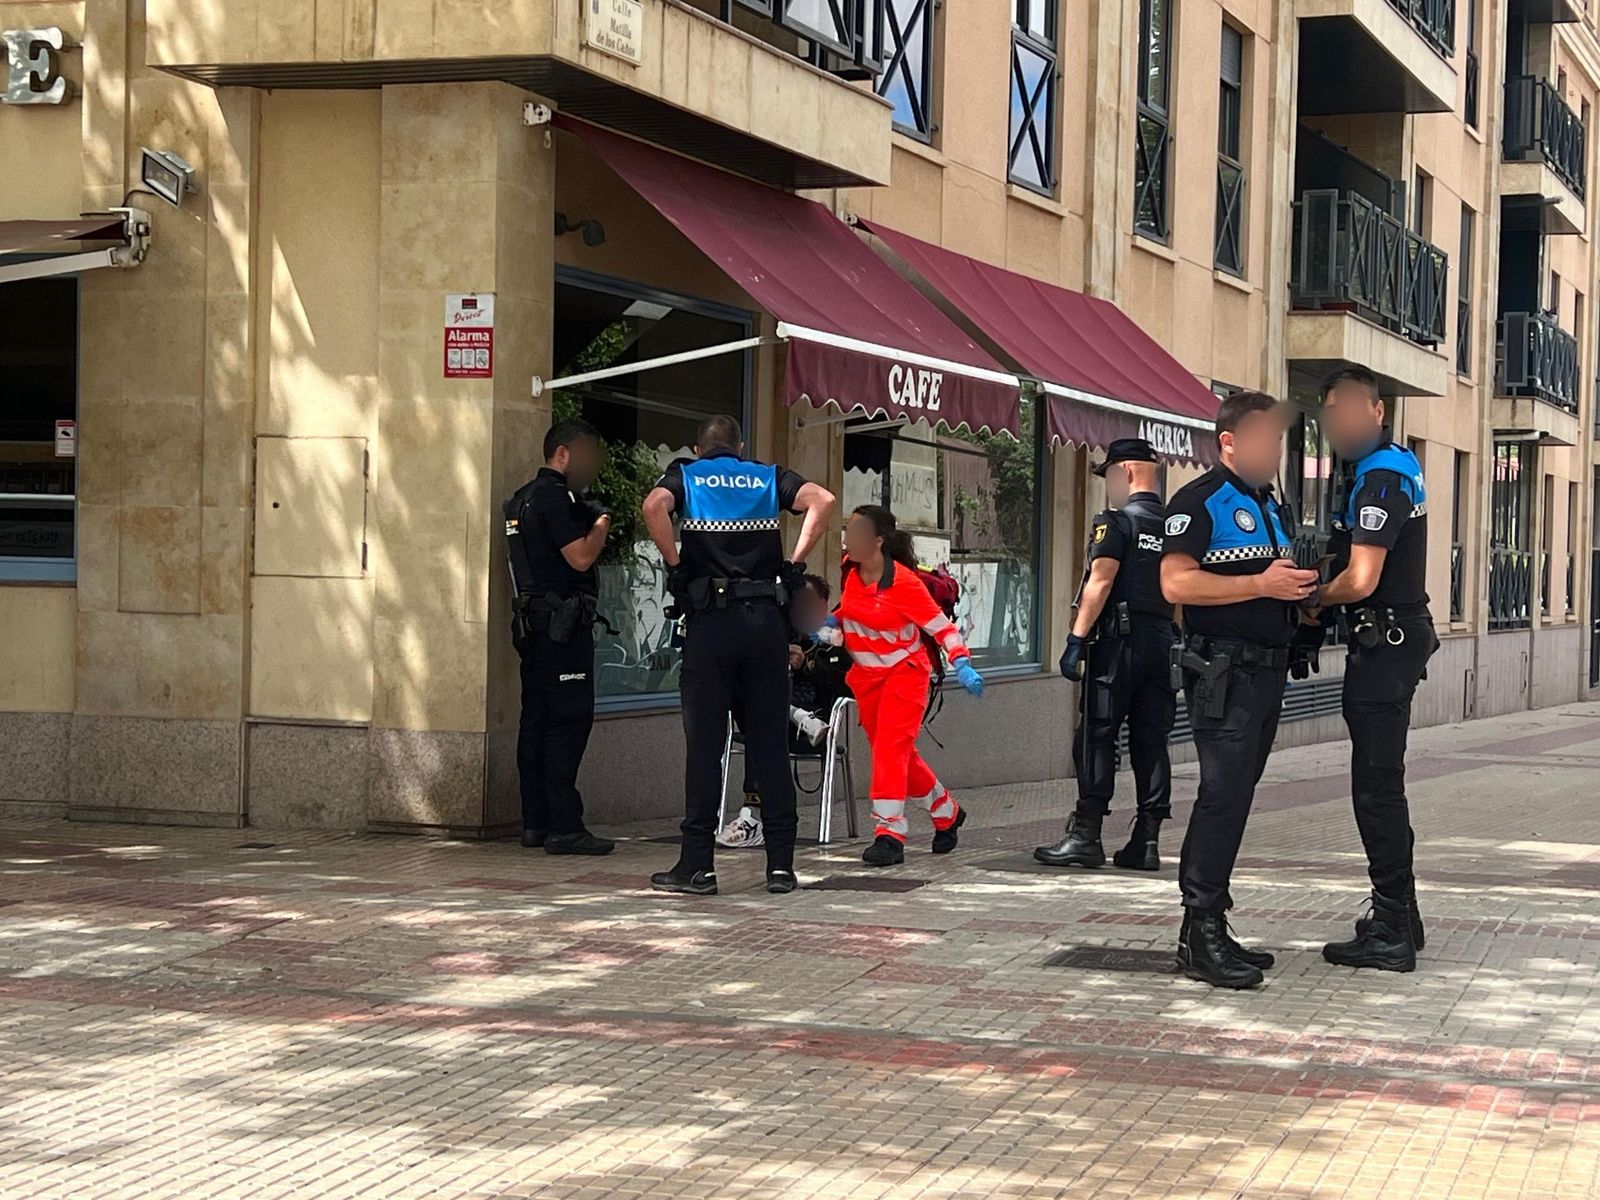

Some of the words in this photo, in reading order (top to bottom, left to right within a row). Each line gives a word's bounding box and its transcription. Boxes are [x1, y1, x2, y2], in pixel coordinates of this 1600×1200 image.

[612, 0, 632, 17] Calle
[596, 30, 605, 45] de
[605, 32, 615, 50] los
[2, 27, 66, 104] E
[447, 329, 490, 342] Alarma
[888, 364, 943, 411] CAFE
[1138, 419, 1193, 457] AMERICA
[694, 474, 766, 489] POLICÍA
